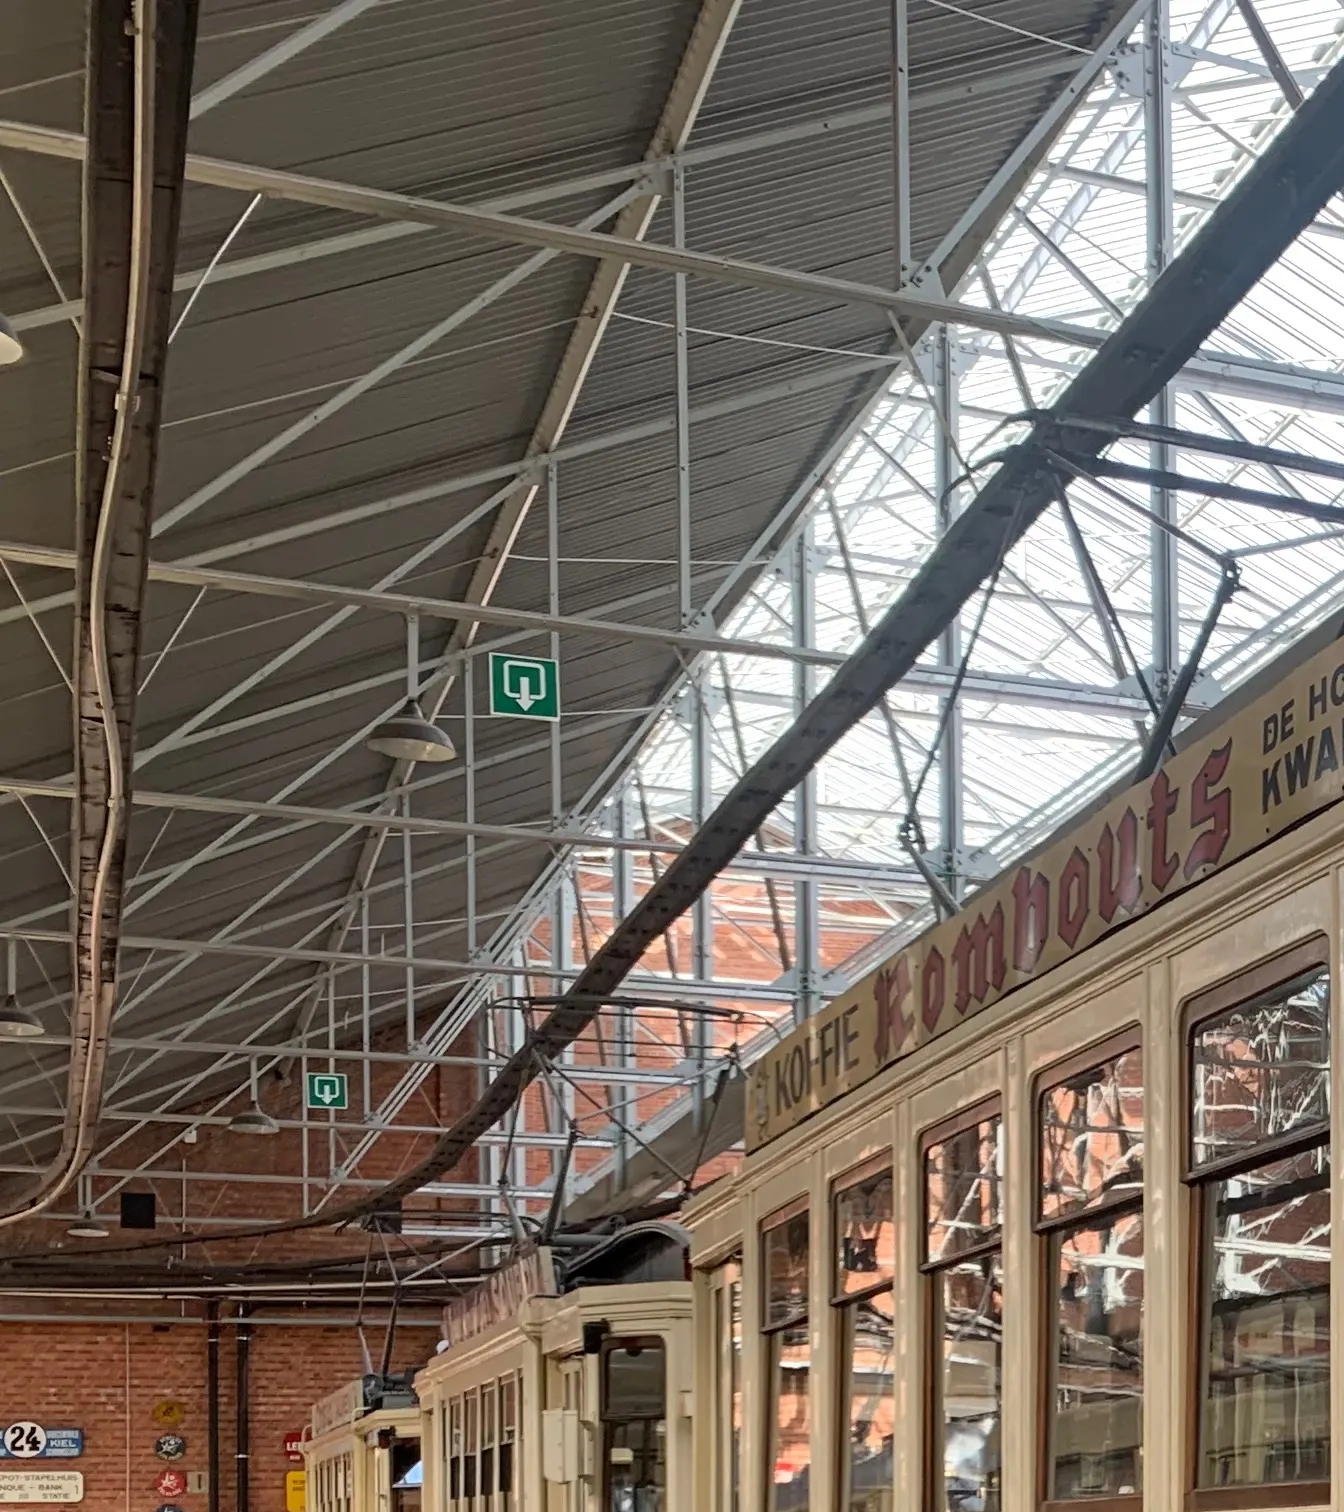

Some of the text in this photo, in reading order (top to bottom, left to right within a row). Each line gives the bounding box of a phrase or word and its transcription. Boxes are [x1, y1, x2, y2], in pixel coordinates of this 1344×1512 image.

[1262, 708, 1296, 756] DE
[775, 1004, 860, 1116] KOFFIE
[10, 1425, 41, 1452] 24
[49, 1439, 77, 1448] KIEL
